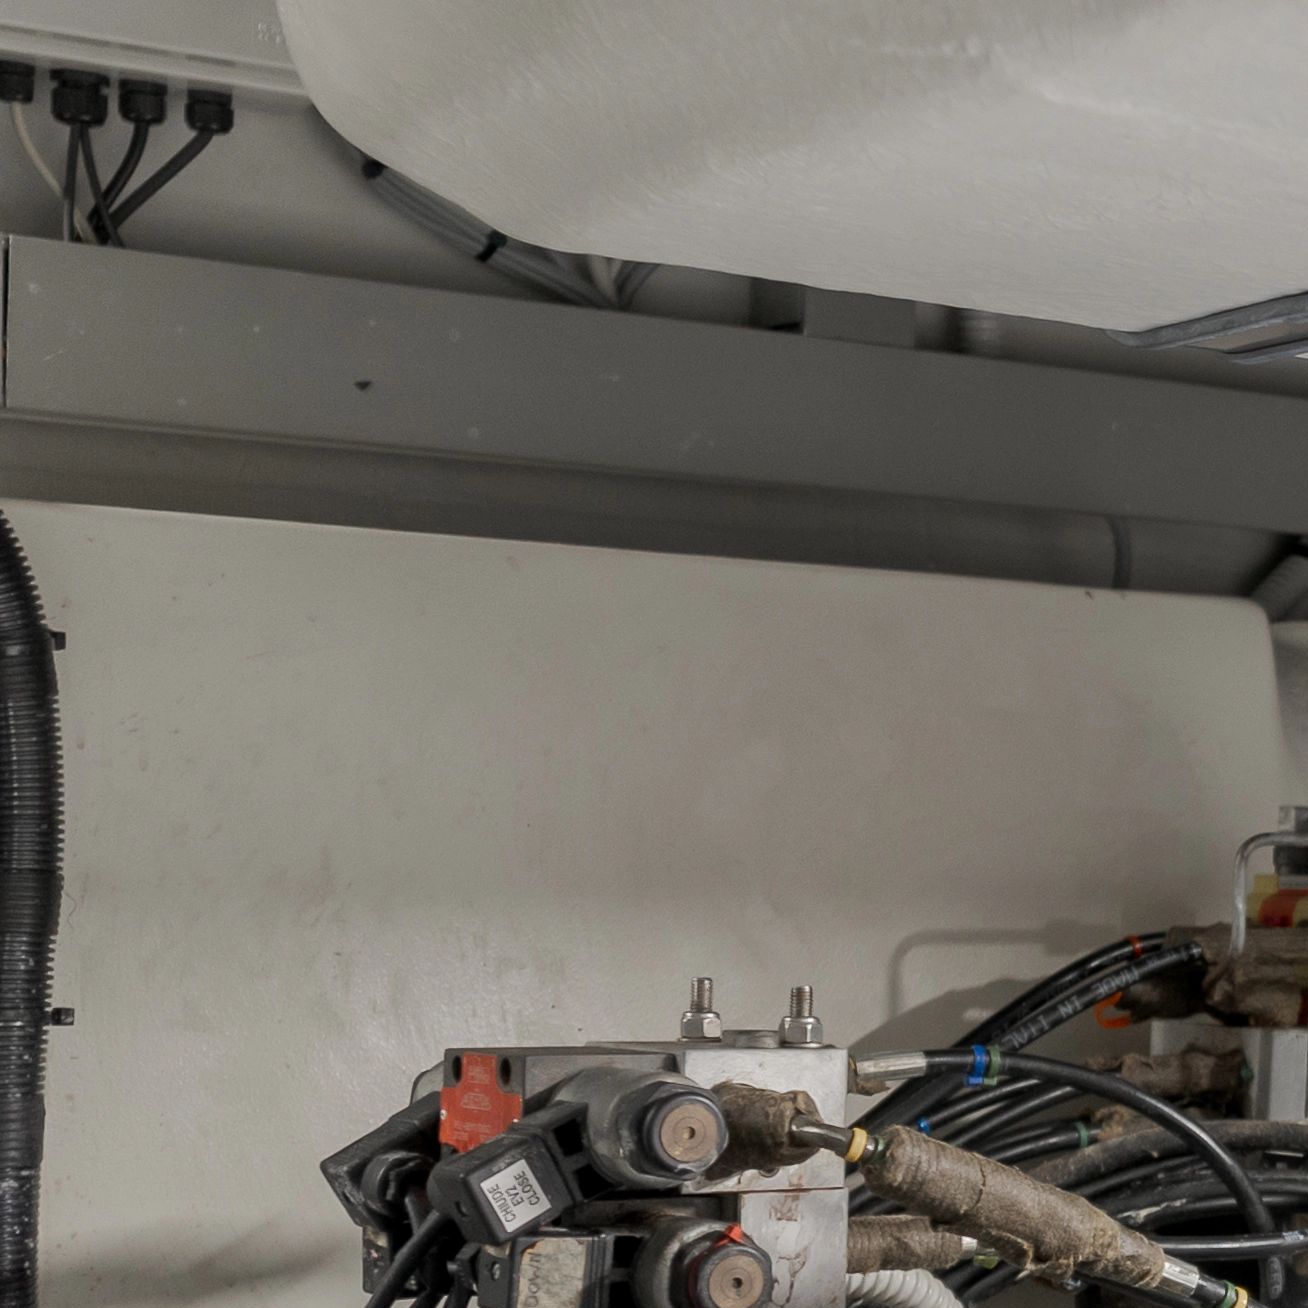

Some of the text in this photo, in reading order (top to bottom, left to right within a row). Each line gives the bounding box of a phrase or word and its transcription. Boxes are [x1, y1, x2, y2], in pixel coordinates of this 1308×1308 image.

[1001, 1015, 1049, 1048] ITAL
[487, 1183, 516, 1223] CHIUDE
[513, 1170, 540, 1206] CLOSE
[526, 1252, 542, 1308] DOWN
